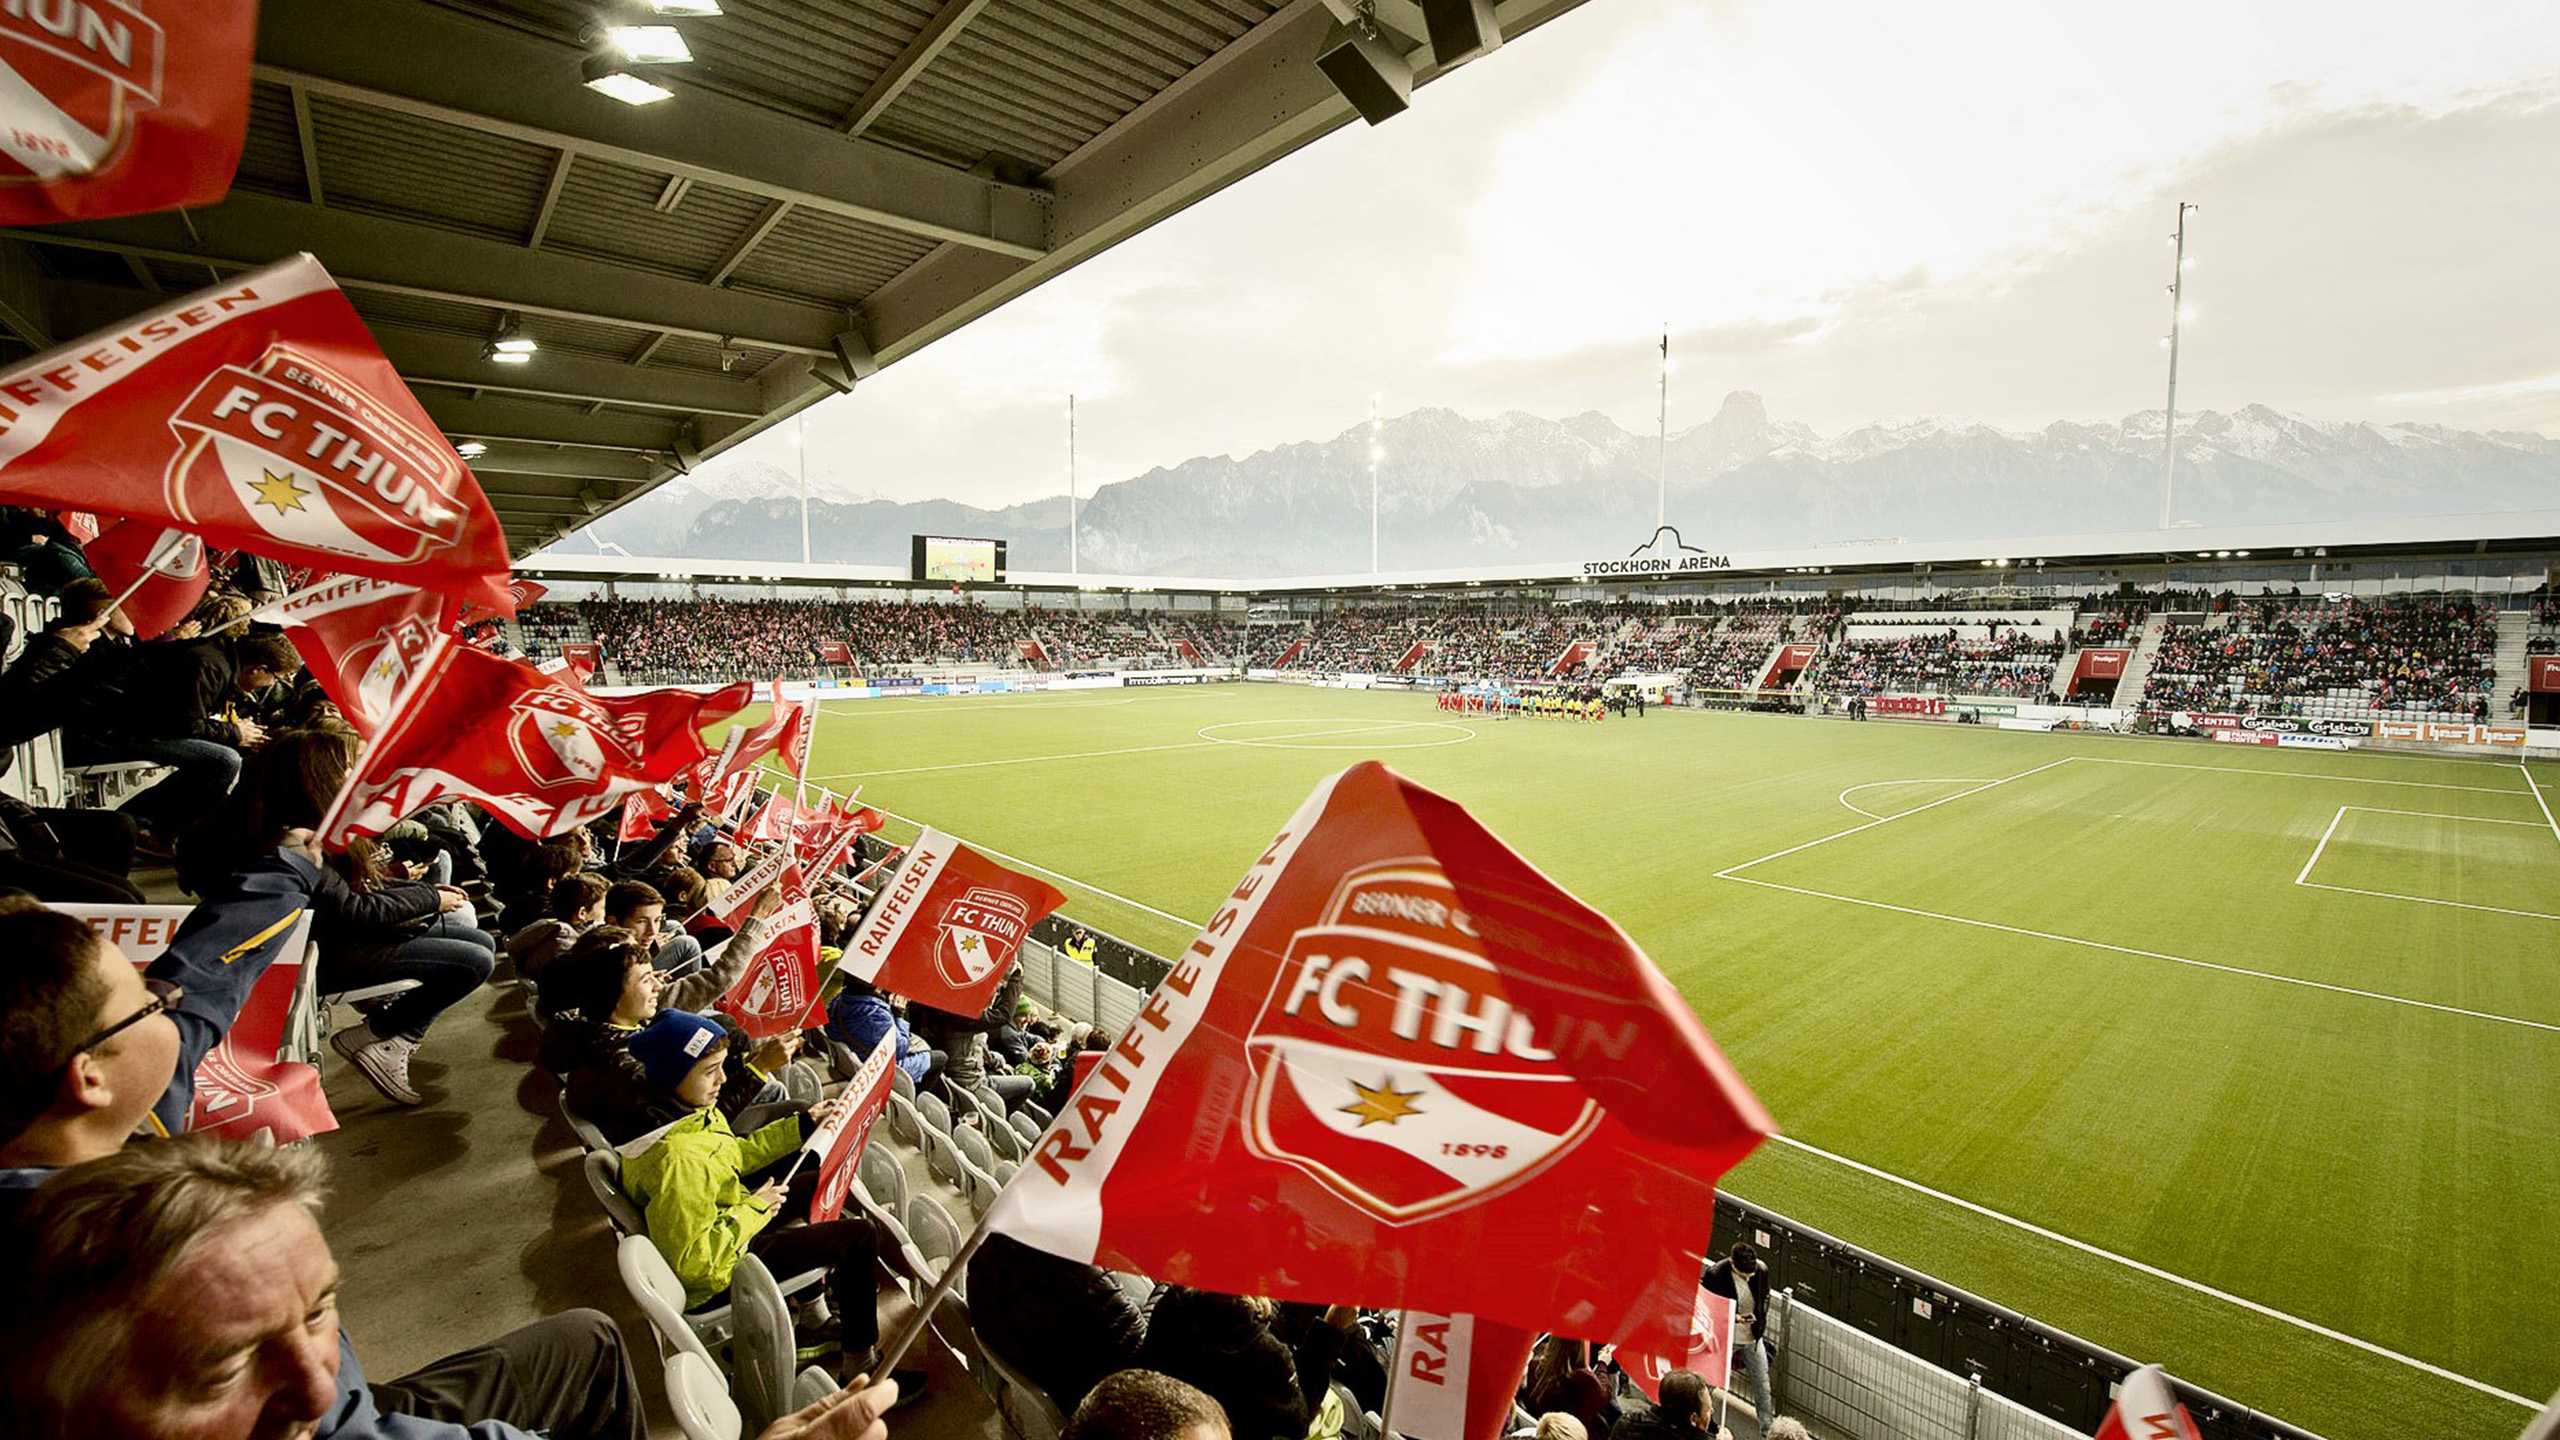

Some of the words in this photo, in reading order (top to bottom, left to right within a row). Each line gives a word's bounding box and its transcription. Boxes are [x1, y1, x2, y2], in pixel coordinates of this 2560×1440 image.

[0, 287, 260, 436] IFFEISEN
[284, 366, 357, 411] BERNER
[211, 385, 298, 440] FC
[305, 420, 458, 529] THUN
[1583, 559, 1671, 574] STOCKHORN
[1678, 556, 1731, 570] ARENA
[282, 577, 396, 614] RAIFFE
[521, 694, 564, 711] FC
[2241, 715, 2300, 732] Carlsberg
[2308, 718, 2370, 736] Carlsberg
[859, 850, 938, 957] RAIFFEISEN
[763, 911, 798, 941] EISEN
[952, 906, 978, 925] FC
[979, 912, 1019, 940] THUN
[772, 955, 786, 971] FC
[778, 973, 795, 1013] THUN
[1033, 831, 1292, 1187] RAIFFEISEN
[1284, 954, 1371, 1027] FC
[1441, 1143, 1508, 1159] 1898
[1410, 1314, 1451, 1386] RA
